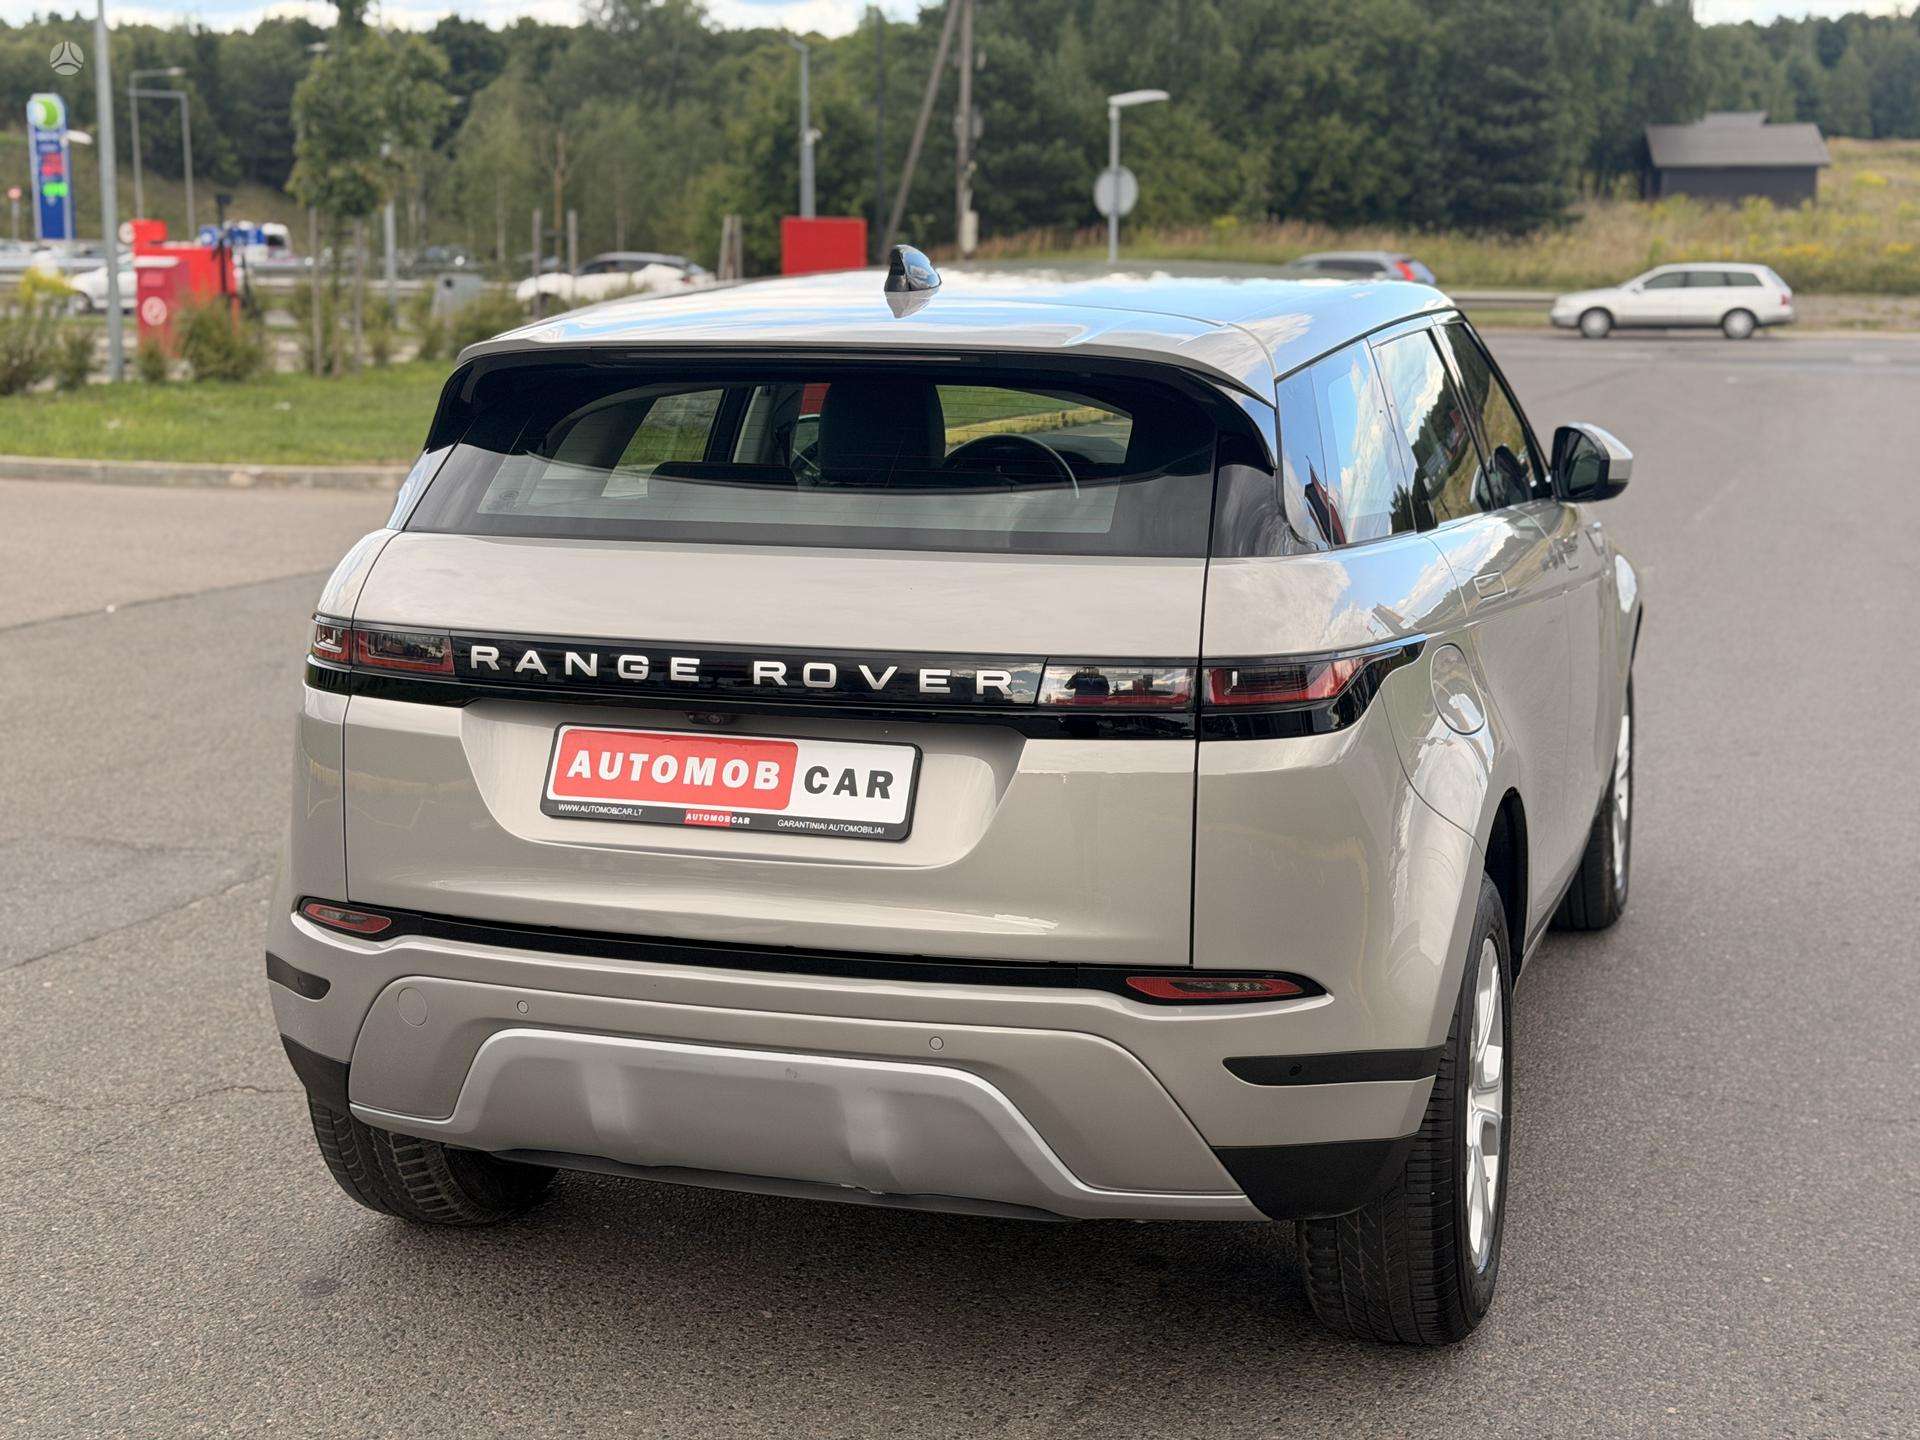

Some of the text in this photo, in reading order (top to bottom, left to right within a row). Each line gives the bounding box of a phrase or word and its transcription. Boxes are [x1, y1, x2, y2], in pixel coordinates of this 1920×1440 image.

[471, 645, 1014, 696] RANGE ROVER
[566, 749, 894, 799] AUTOMOB CAR
[558, 803, 643, 816] WWW.AUTOMOBCAR.LT
[777, 819, 885, 834] GARANTINIAI AUTOMOBILIAI
